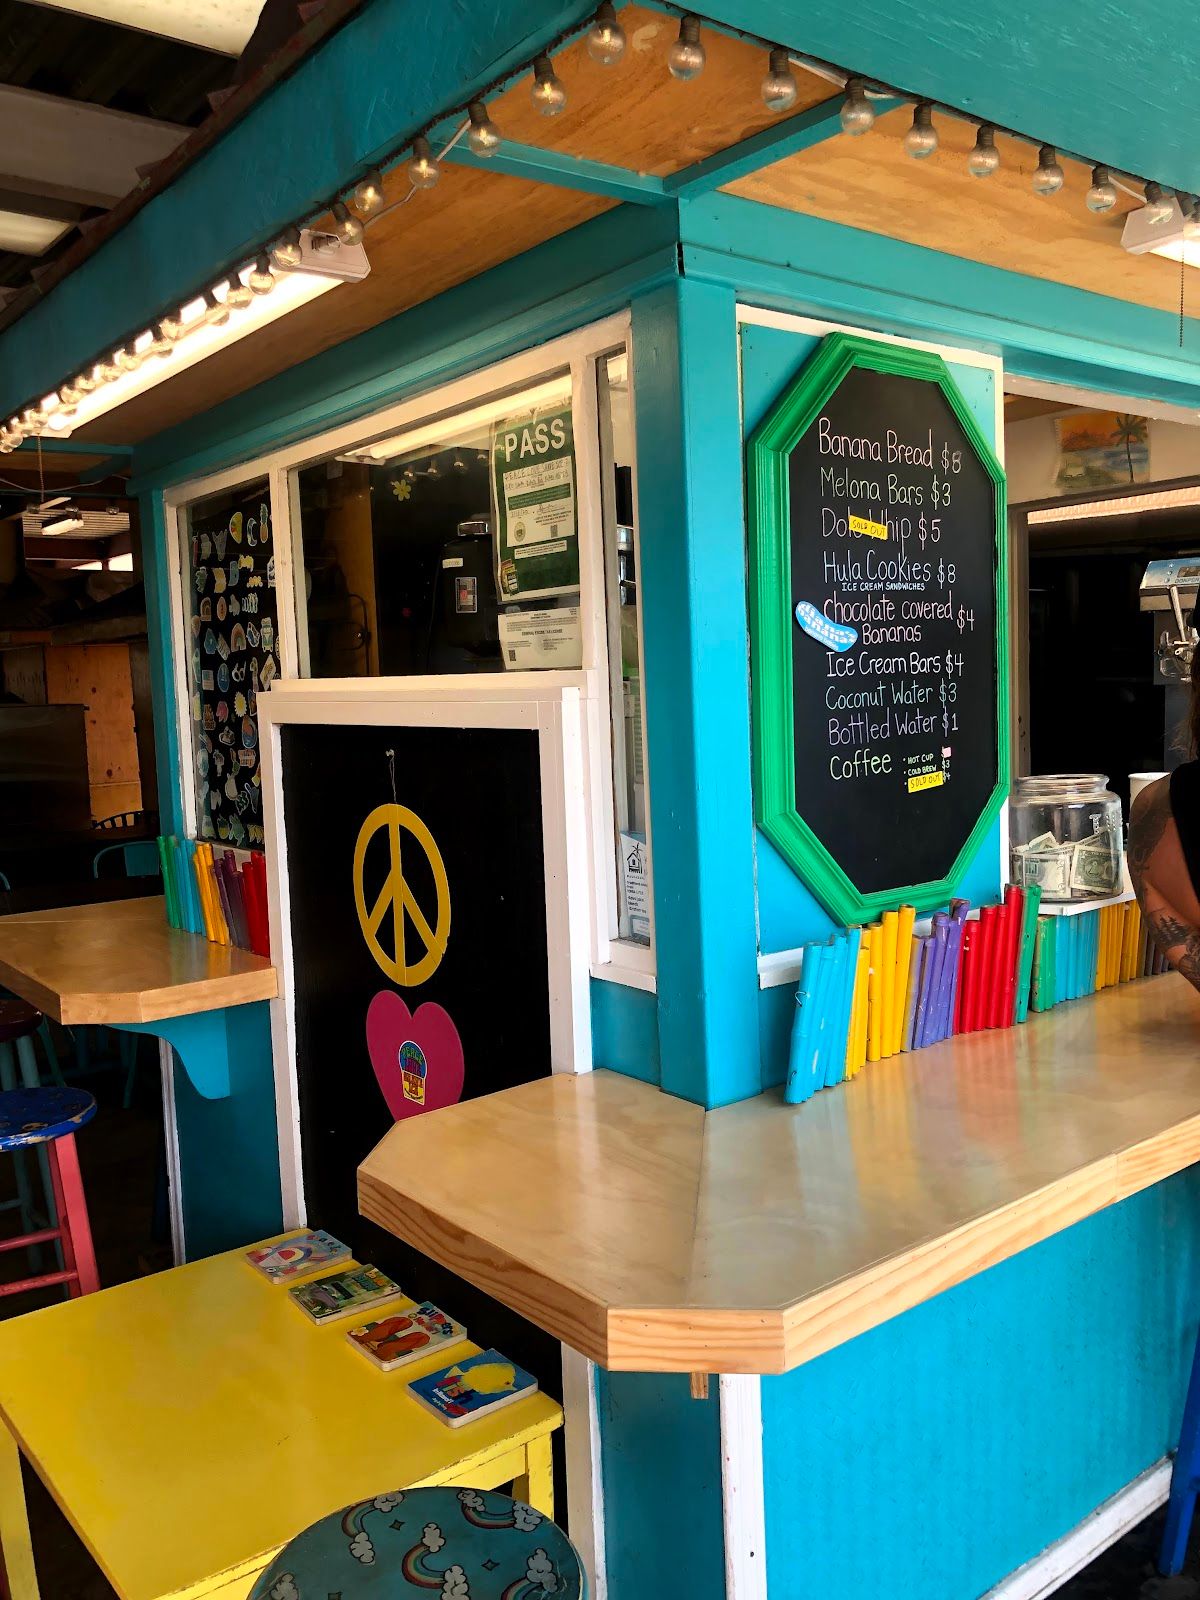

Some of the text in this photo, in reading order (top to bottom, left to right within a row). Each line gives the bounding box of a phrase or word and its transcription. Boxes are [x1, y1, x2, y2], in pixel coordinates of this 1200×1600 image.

[504, 418, 566, 463] PASS
[818, 417, 963, 475] Banana Bread $8
[820, 466, 951, 510] Melona Bars $3
[851, 519, 887, 537] SOLD OUT
[918, 511, 942, 550] $5
[823, 549, 957, 590] Hula Cookies $8
[841, 582, 926, 592] ICE CREAM SANDWICHES
[901, 590, 954, 621] covered
[956, 603, 975, 635] $4
[861, 622, 922, 646] Bananas
[826, 649, 965, 680] Ice Cream Bars $4
[825, 677, 958, 710] Coconut Water $3
[828, 706, 960, 746] Bottled Water $1
[829, 748, 893, 781] Coffee
[907, 753, 934, 765] HOT CUP
[907, 767, 922, 777] COLD
[922, 764, 937, 774] BREW
[910, 776, 927, 789] SOLD
[928, 773, 941, 784] OUT
